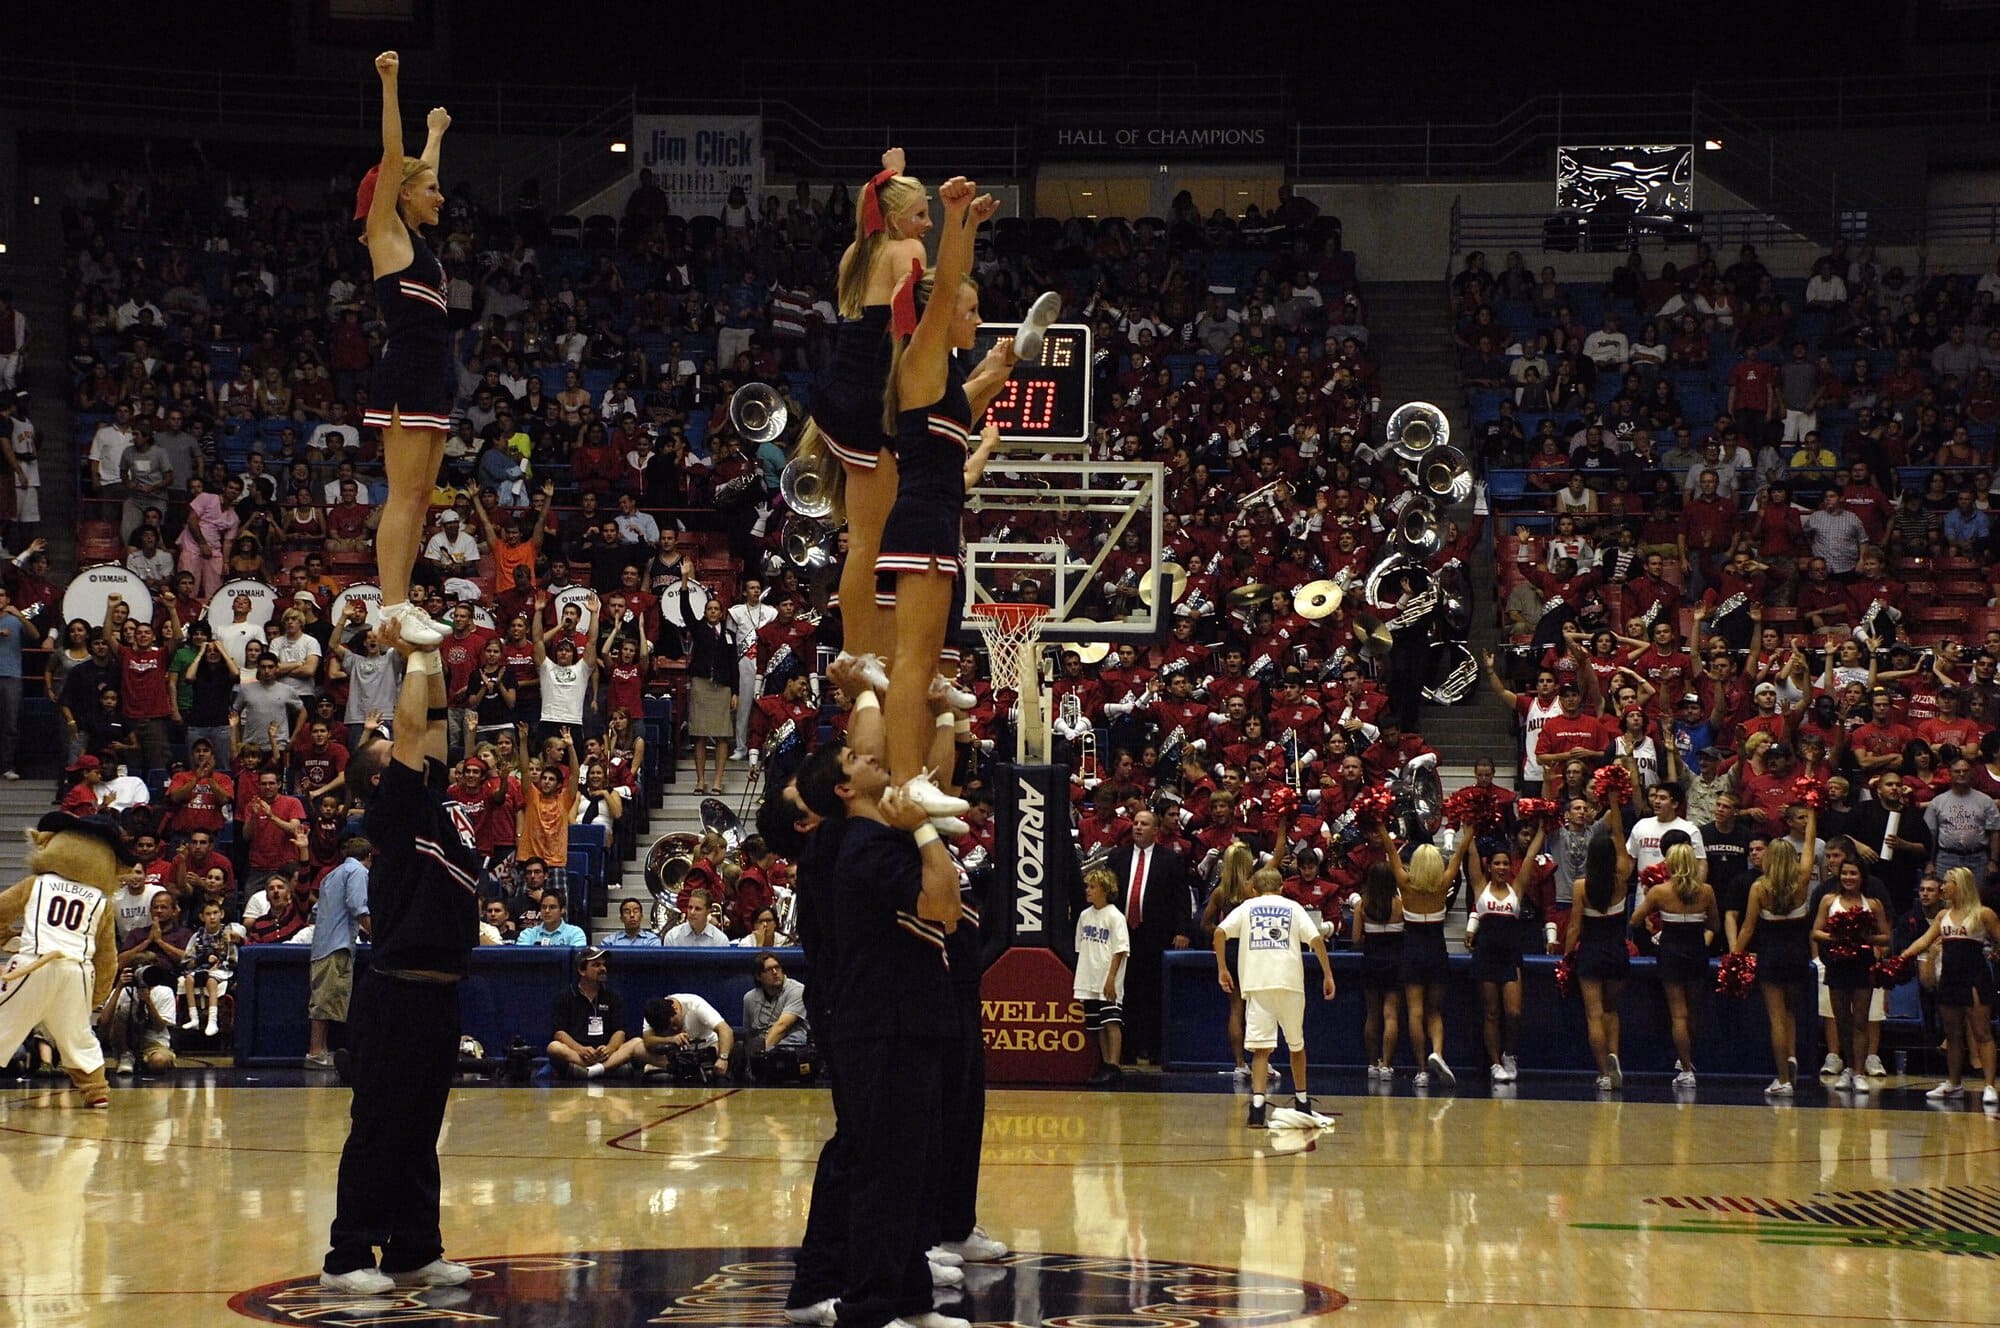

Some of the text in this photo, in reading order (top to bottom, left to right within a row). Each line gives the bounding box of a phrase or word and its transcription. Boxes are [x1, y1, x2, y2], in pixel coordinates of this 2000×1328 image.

[1058, 128, 1264, 145] HALL OF CHAMPIONS
[643, 130, 752, 166] Jim Click
[985, 380, 1056, 429] 20
[99, 575, 128, 583] YAMAHA
[236, 589, 265, 598] YAMAHA
[353, 593, 382, 601] YAMAHA
[1016, 777, 1045, 933] ARIZONA
[1704, 843, 1745, 854] ARIZONA
[49, 883, 94, 899] WILBUR
[47, 896, 84, 930] 00
[980, 1000, 1086, 1024] WELLS
[981, 1028, 1086, 1052] FARGO
